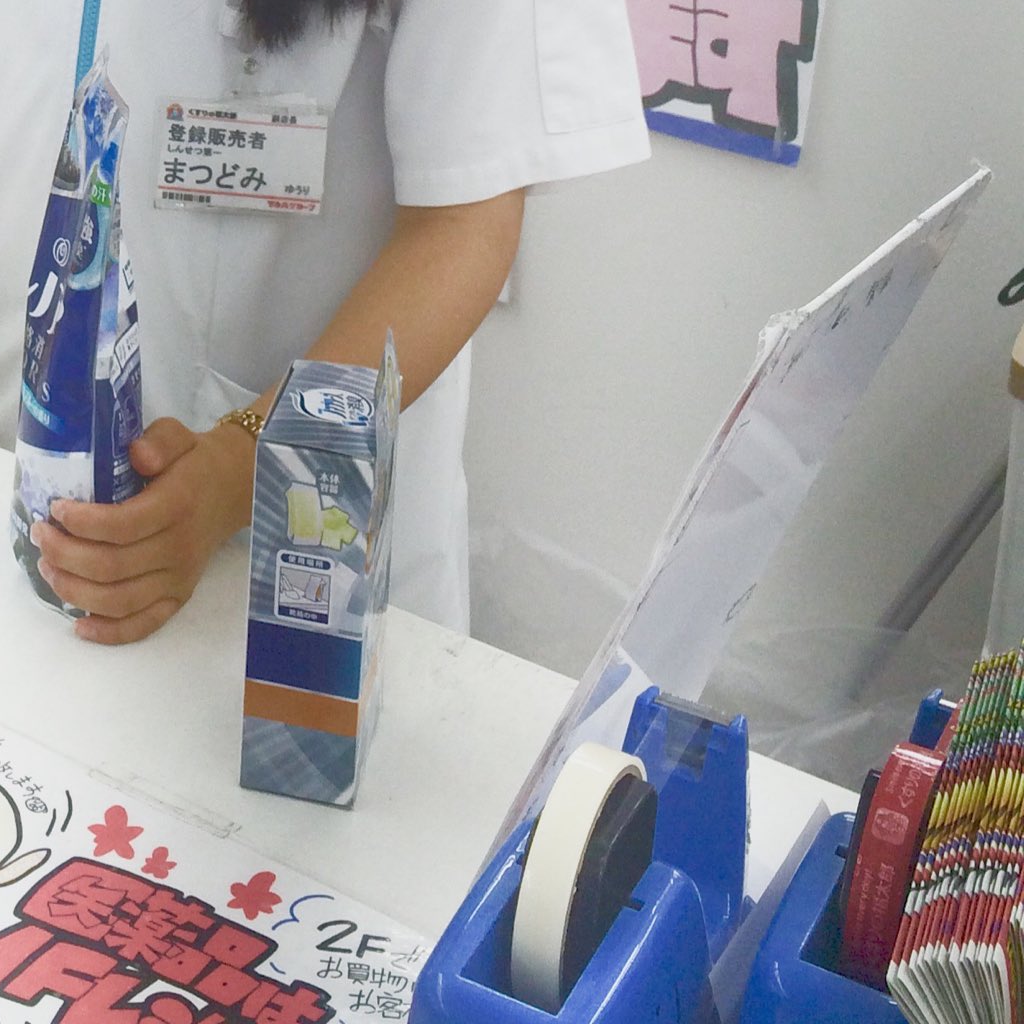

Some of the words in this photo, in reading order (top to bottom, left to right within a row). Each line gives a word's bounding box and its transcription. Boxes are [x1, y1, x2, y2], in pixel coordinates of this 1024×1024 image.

[168, 123, 268, 150] 登録販売者
[163, 157, 268, 192] まつどみ
